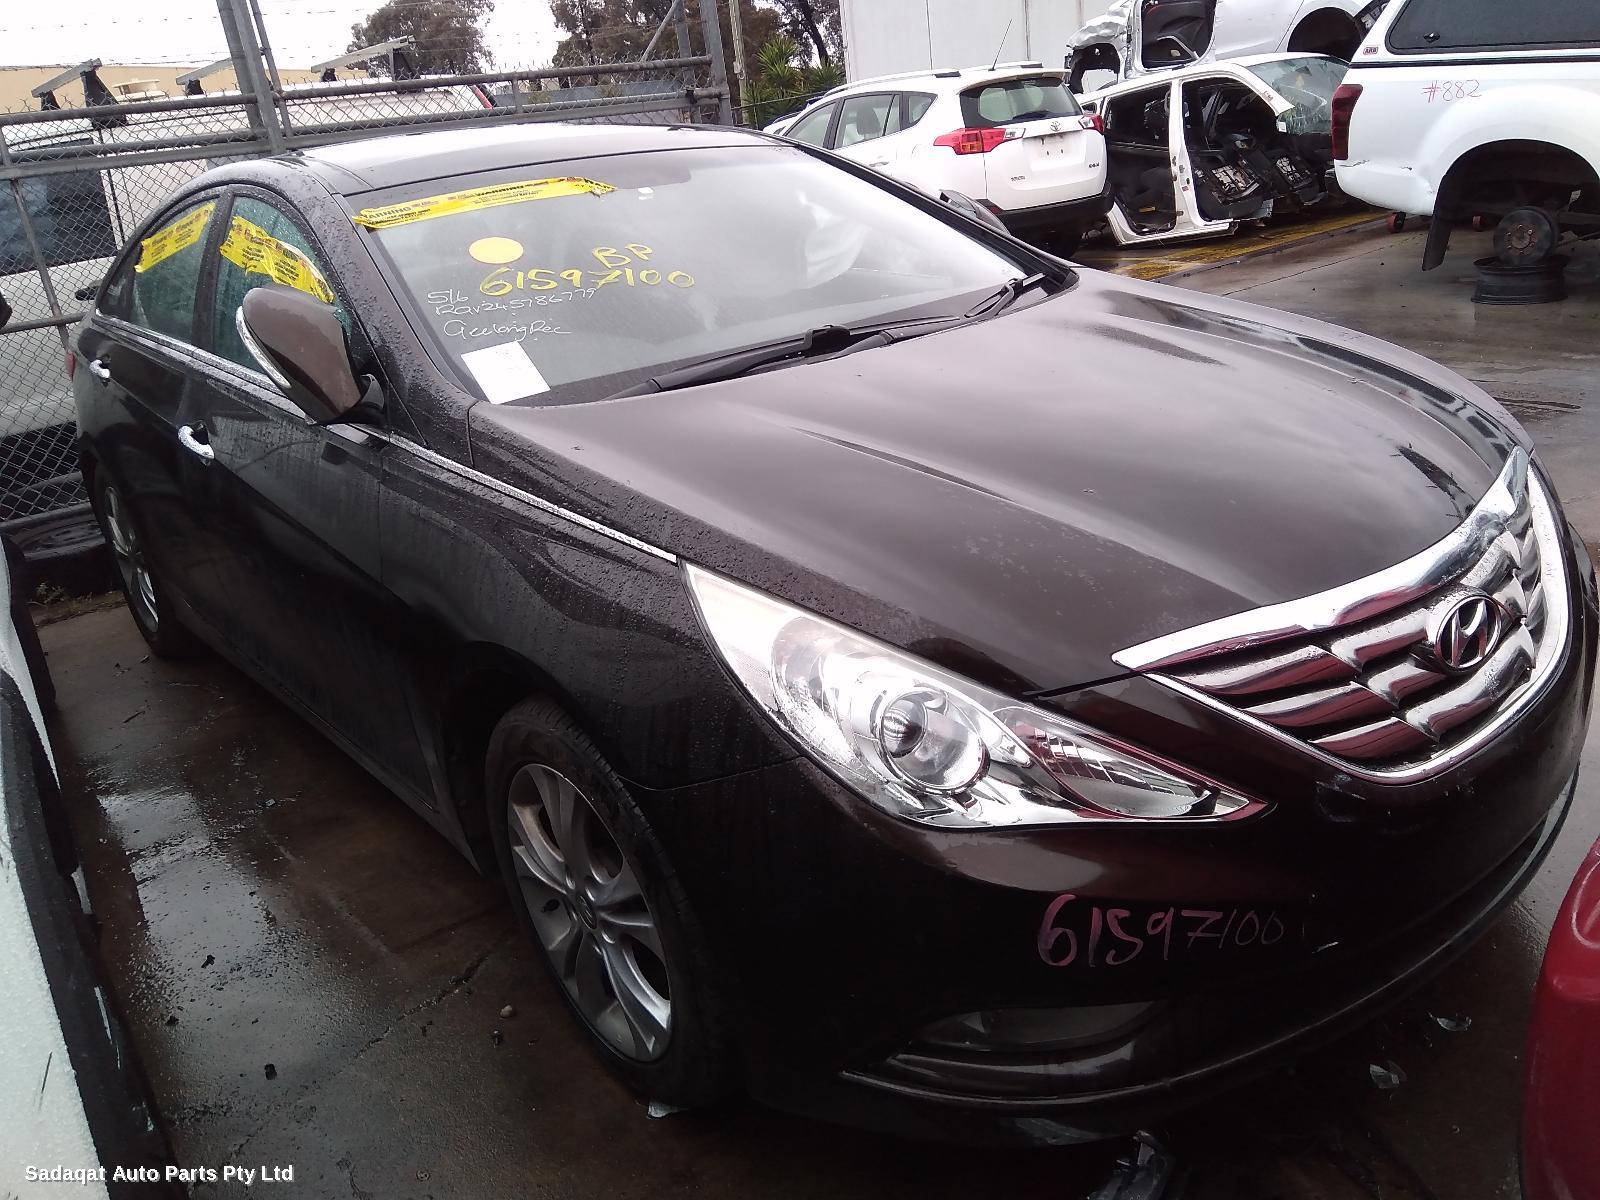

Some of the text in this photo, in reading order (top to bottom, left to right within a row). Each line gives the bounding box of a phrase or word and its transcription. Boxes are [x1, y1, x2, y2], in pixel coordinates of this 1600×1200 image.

[1422, 79, 1482, 103] #882
[479, 266, 695, 296] 61597100
[1037, 893, 1284, 967] 61597100
